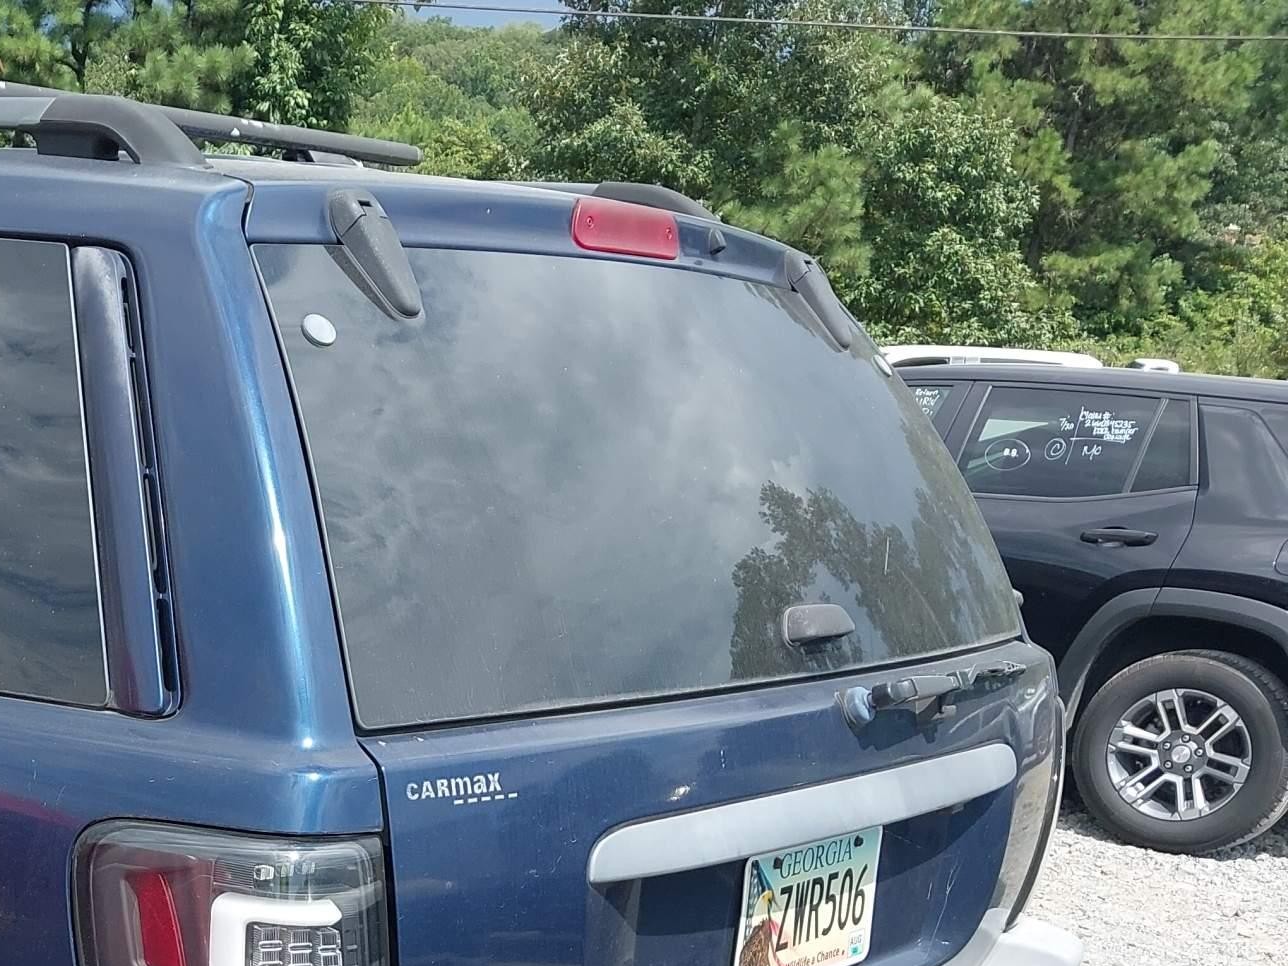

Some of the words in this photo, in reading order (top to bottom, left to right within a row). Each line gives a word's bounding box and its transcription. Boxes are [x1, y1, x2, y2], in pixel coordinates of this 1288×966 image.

[780, 837, 853, 879] GEORGIA
[775, 864, 869, 952] ZWR506
[816, 948, 840, 963] Chance
